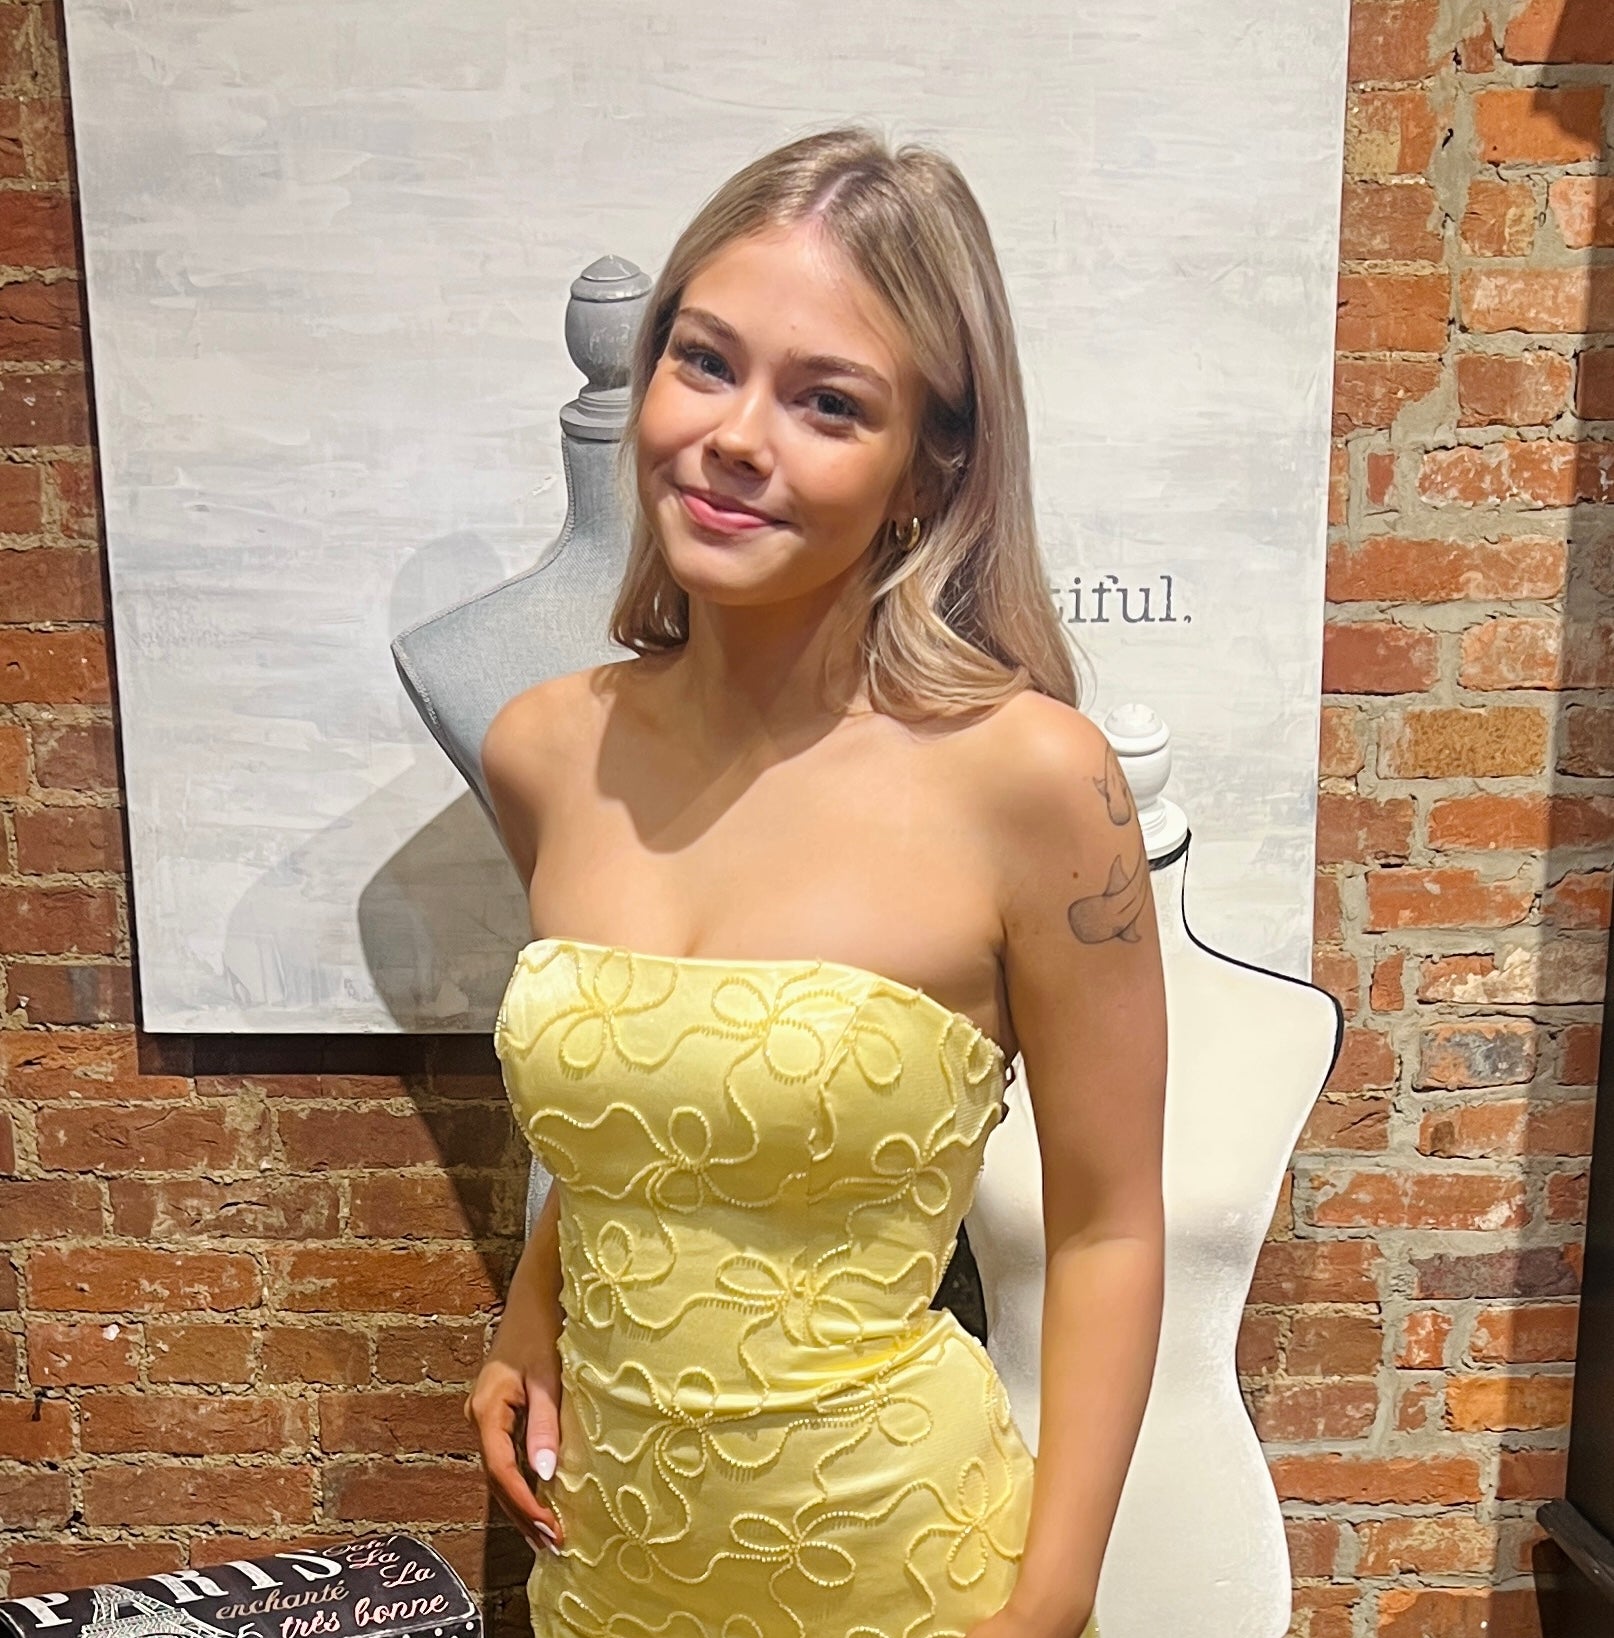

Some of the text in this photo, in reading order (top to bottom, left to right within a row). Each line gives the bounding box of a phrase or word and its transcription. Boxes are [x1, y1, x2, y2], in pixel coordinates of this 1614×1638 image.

[346, 1548, 400, 1569] La
[379, 1561, 436, 1588] La
[215, 1579, 350, 1620] enchanté
[354, 1594, 449, 1627] bonne
